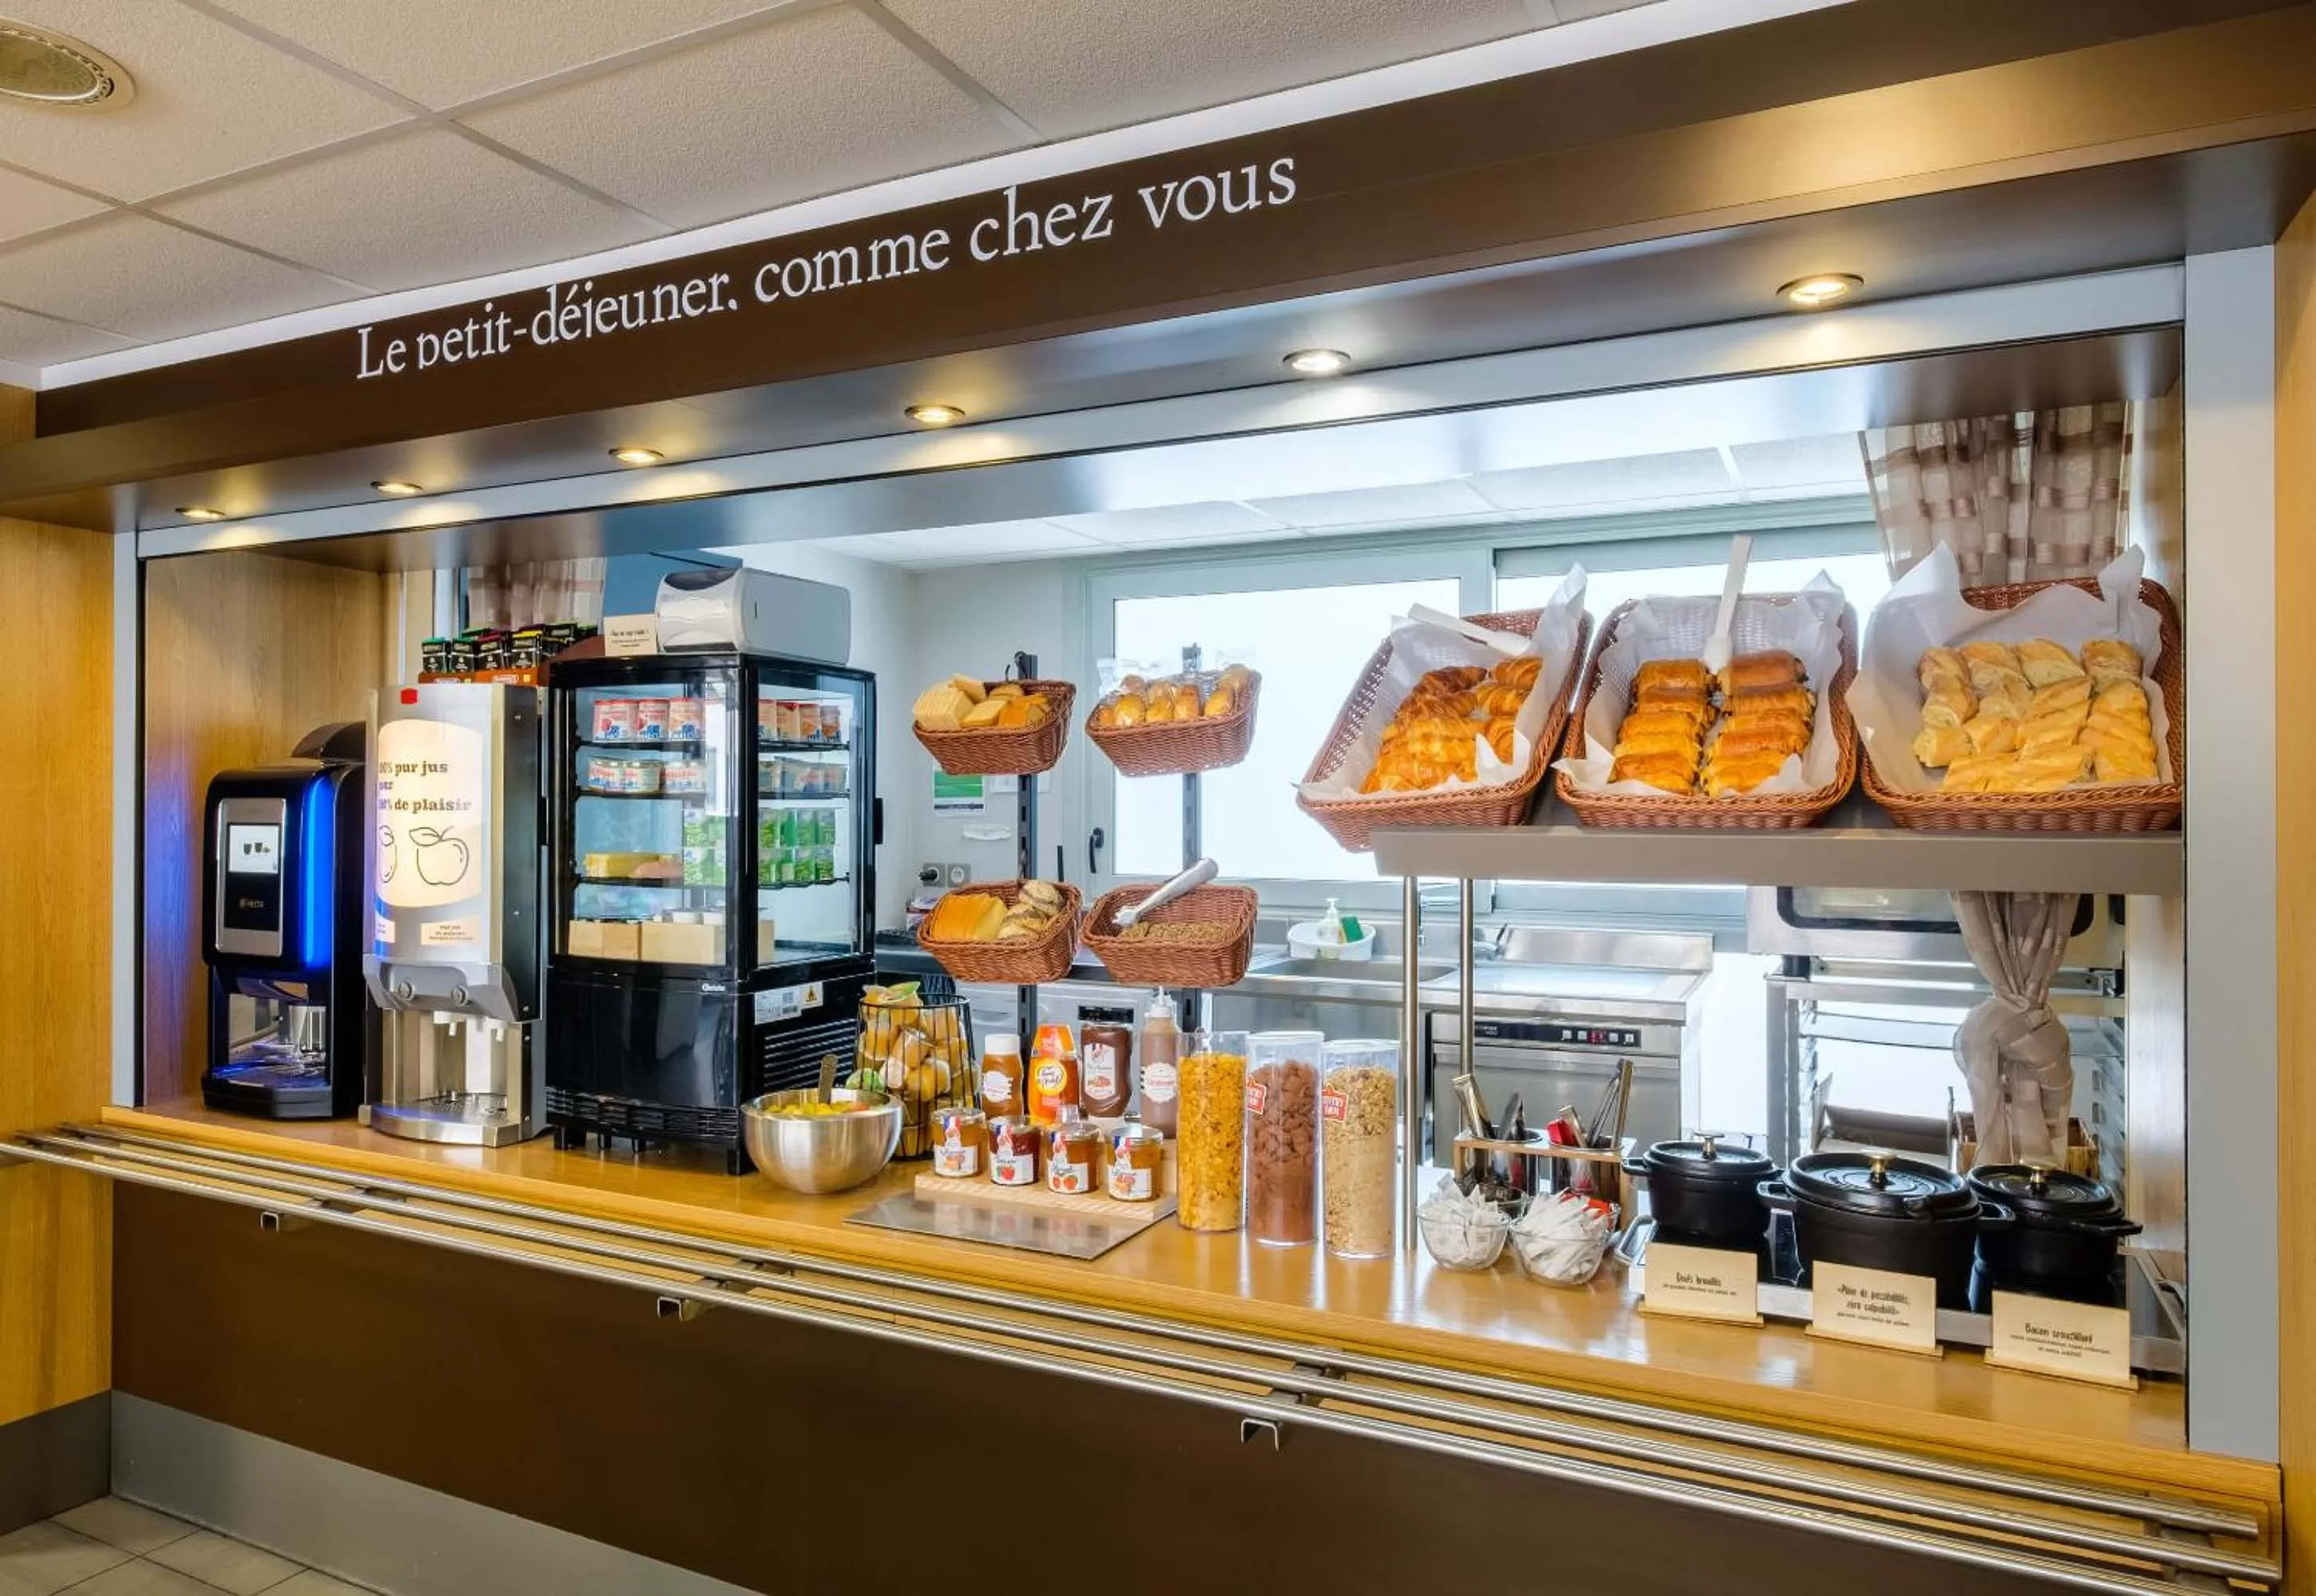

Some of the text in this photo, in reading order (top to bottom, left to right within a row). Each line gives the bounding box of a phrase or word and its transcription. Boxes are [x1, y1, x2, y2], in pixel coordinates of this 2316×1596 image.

[357, 326, 406, 380] Le
[755, 229, 950, 303] comme
[970, 185, 1114, 262] chez
[1138, 157, 1297, 229] vous
[395, 762, 418, 777] pur
[420, 760, 448, 777] jus
[395, 798, 409, 811] de
[412, 798, 471, 814] plaisir
